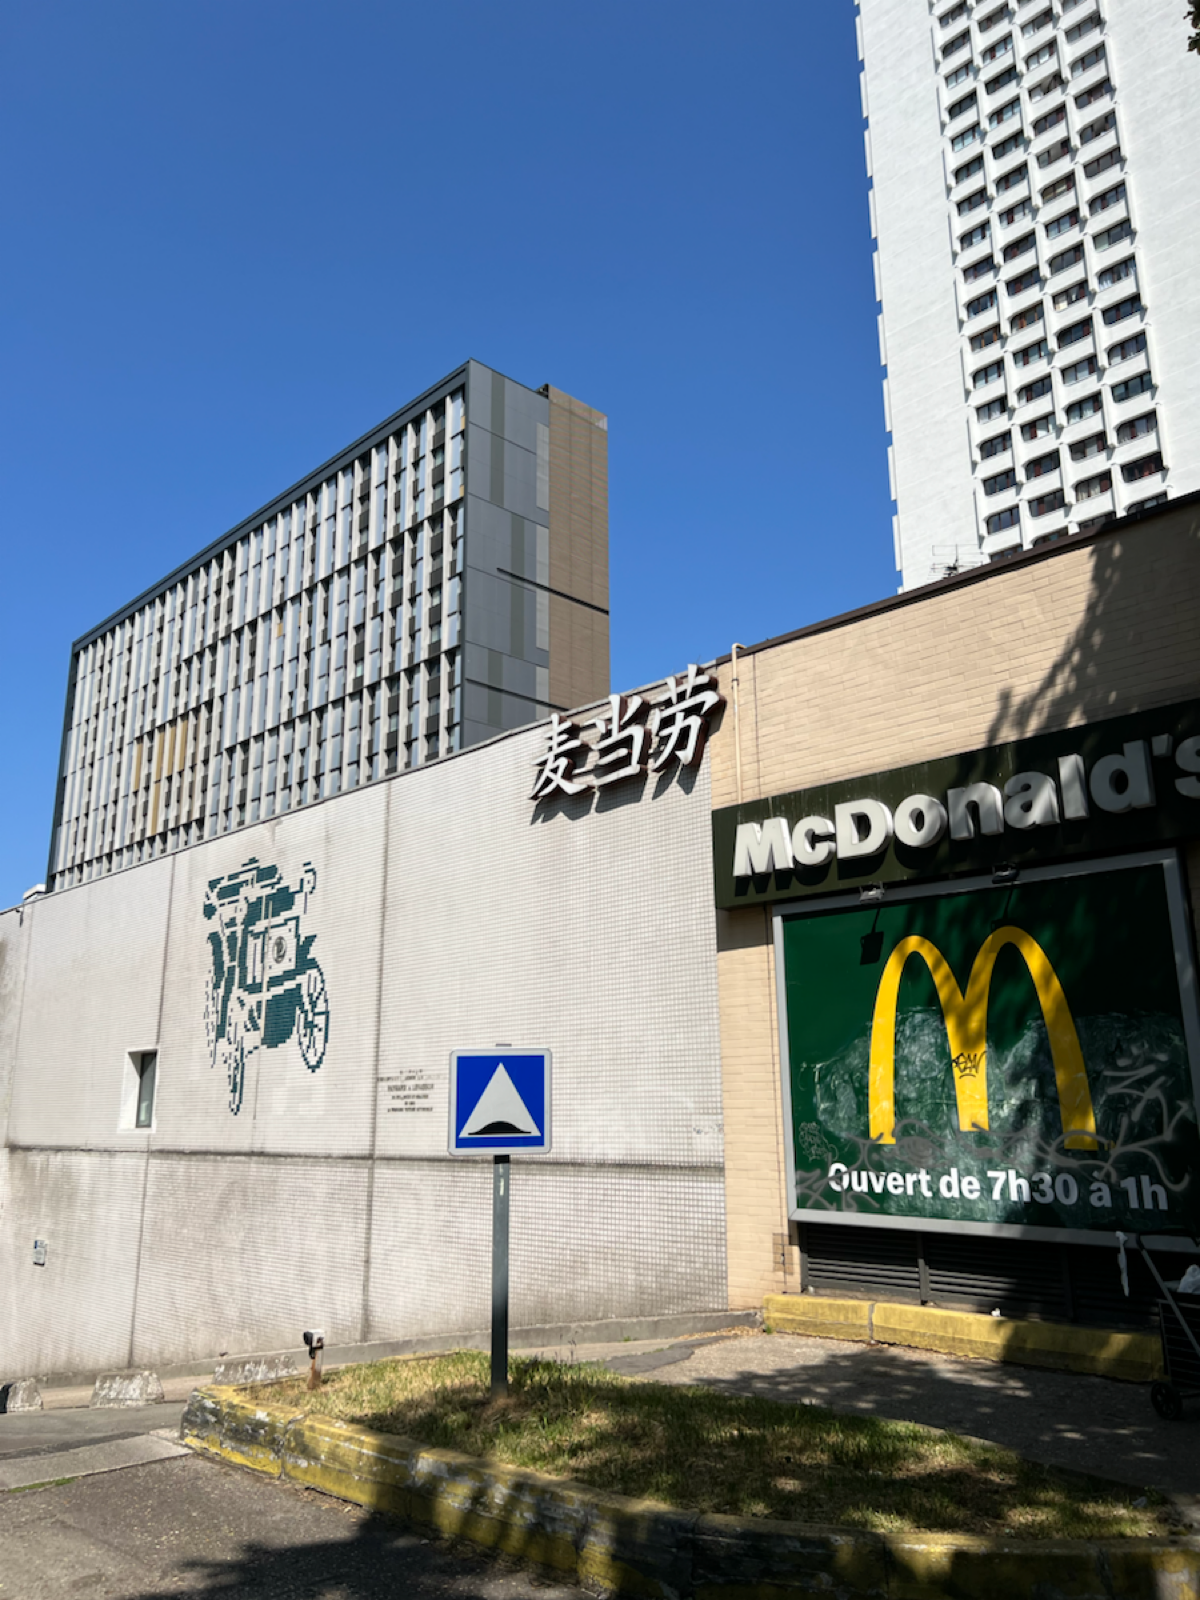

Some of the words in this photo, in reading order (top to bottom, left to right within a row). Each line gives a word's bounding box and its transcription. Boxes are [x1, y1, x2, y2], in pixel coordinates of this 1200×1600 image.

[529, 663, 727, 800] 麦当劳
[868, 925, 1098, 1150] M
[827, 1162, 932, 1198] Ouvert
[939, 1168, 981, 1200] de
[987, 1169, 1078, 1206] 7h30
[1089, 1170, 1112, 1208] à
[1120, 1174, 1169, 1211] 1h
